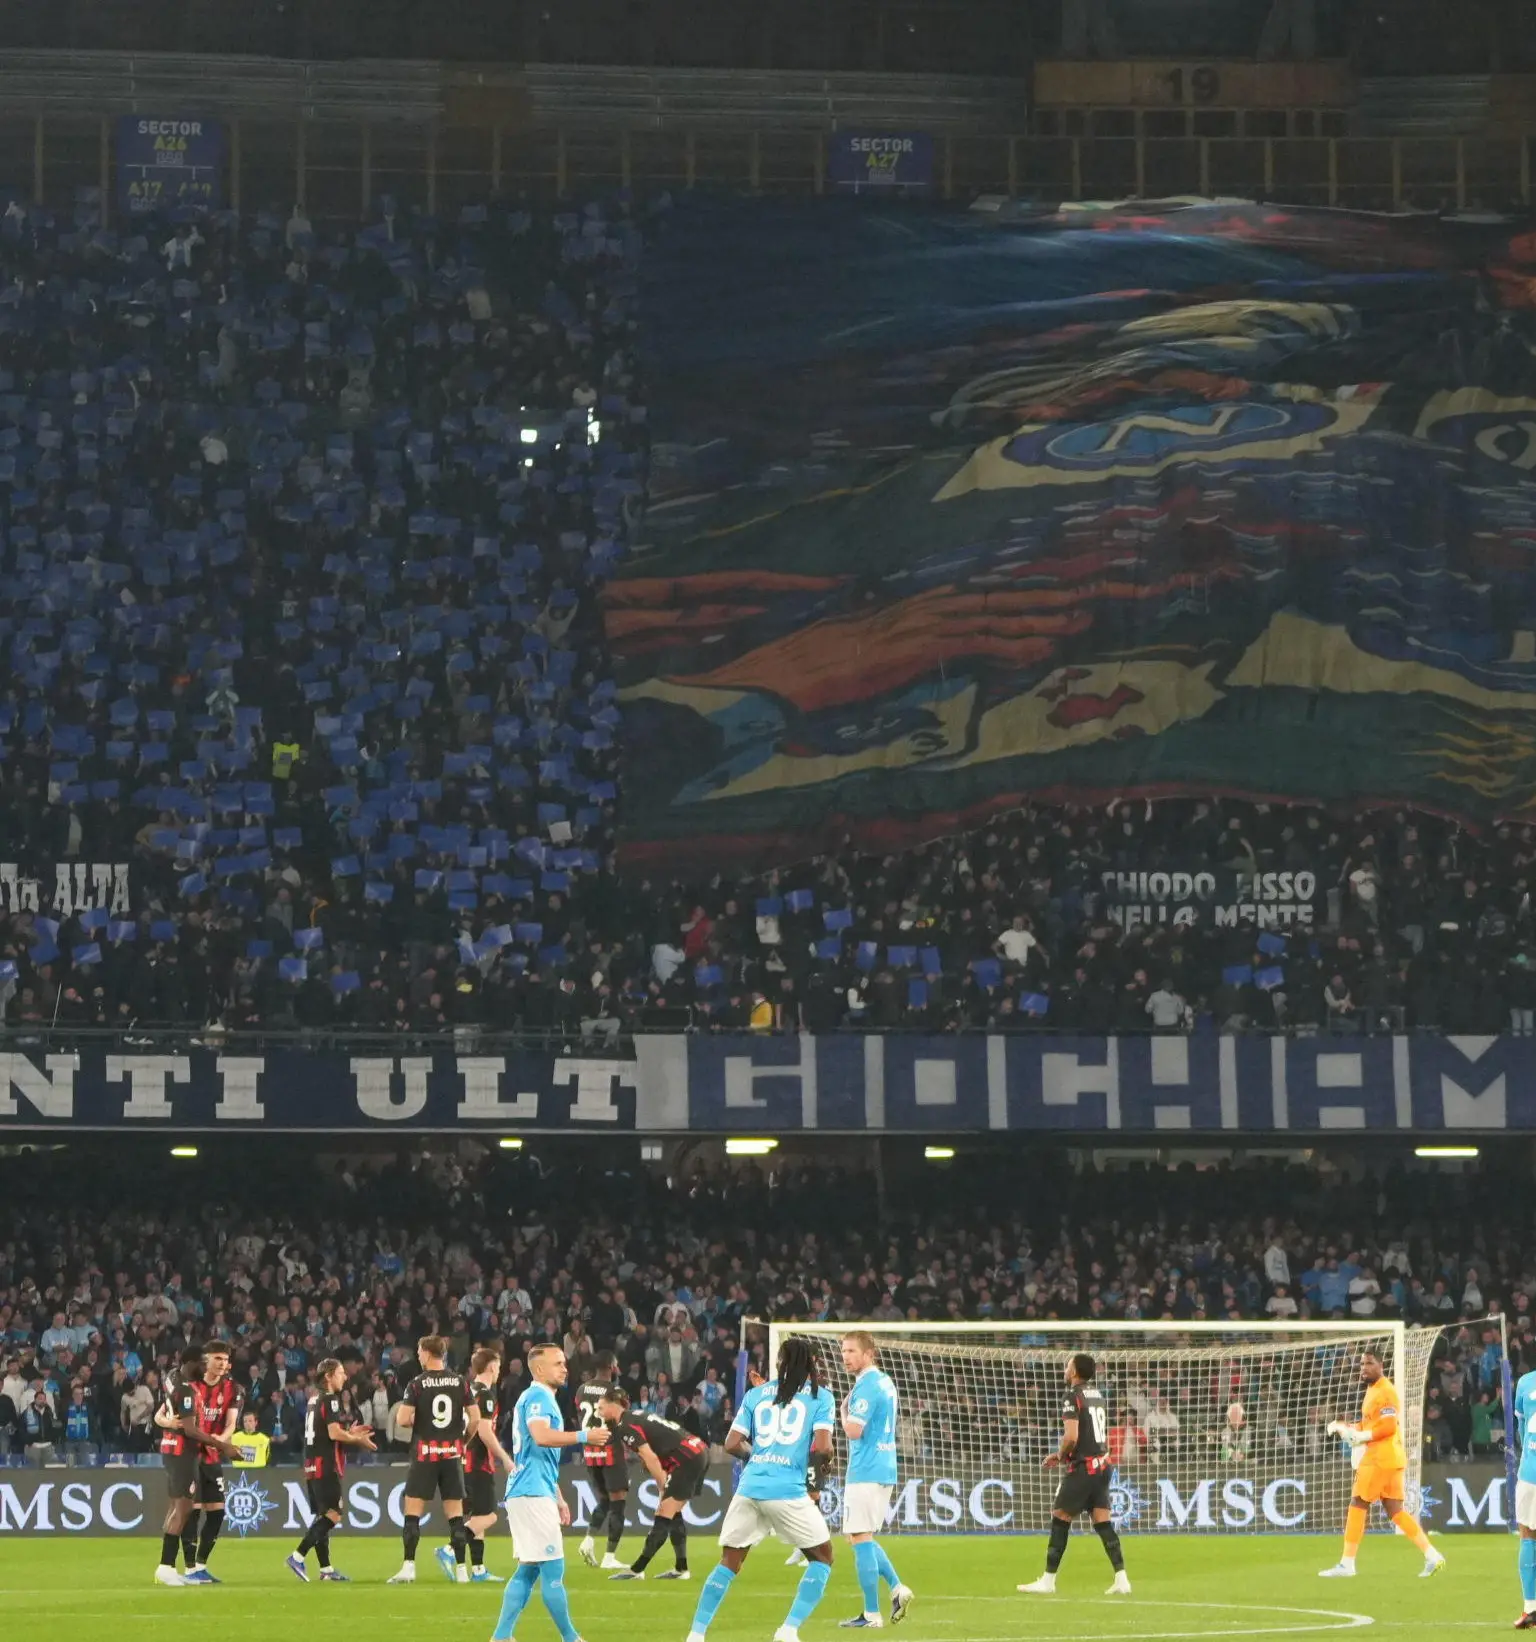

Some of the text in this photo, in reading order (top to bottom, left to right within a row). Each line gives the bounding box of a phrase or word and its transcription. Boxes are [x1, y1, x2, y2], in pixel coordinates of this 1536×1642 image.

[1163, 68, 1220, 103] 19
[138, 121, 202, 136] SECTOR
[154, 136, 187, 150] A26
[851, 138, 913, 151] SECTOR
[866, 153, 900, 168] A27
[53, 863, 130, 917] ALTA
[1215, 904, 1313, 928] MENTE
[432, 1394, 453, 1429] 9
[754, 1398, 806, 1448] 99
[0, 1482, 144, 1531] MSC
[881, 1478, 1014, 1527] MSC
[1156, 1478, 1307, 1528] MSC
